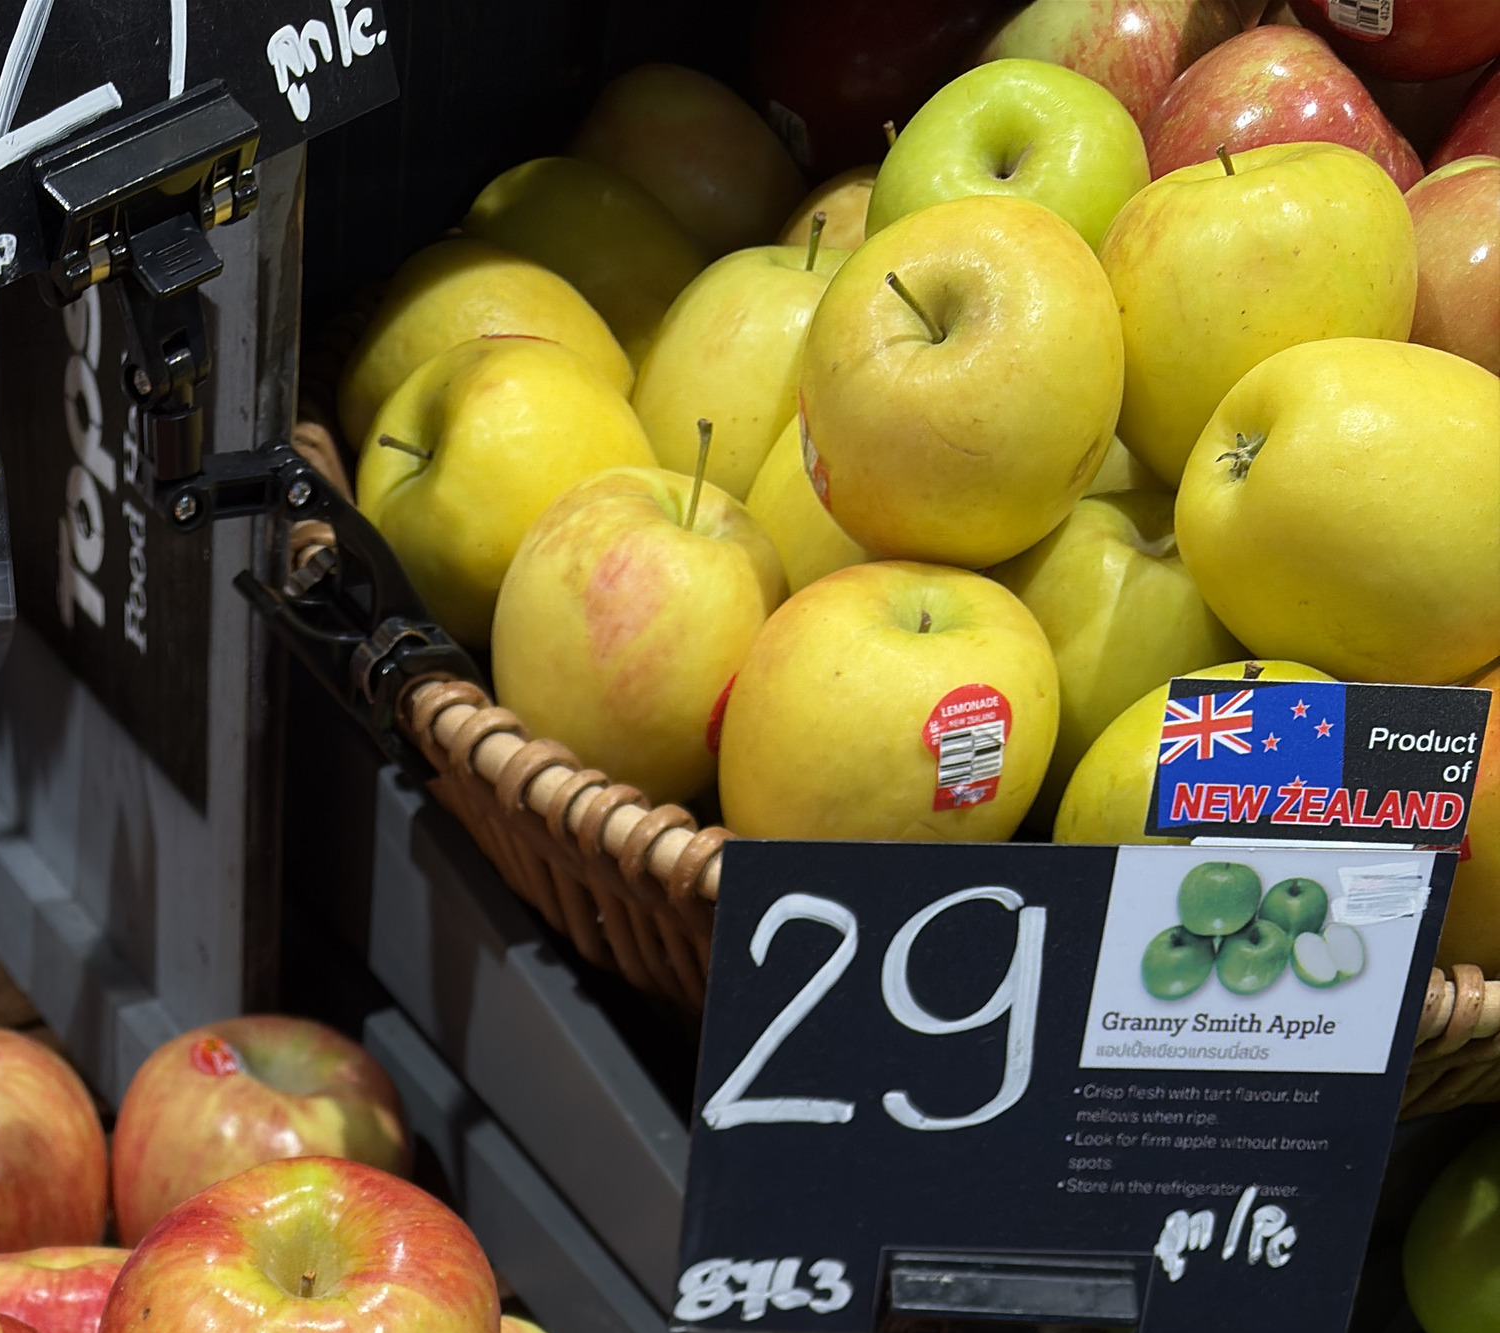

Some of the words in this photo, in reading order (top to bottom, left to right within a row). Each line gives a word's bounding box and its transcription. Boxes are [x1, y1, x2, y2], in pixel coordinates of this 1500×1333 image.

[122, 501, 148, 655] Food
[941, 696, 1000, 717] LEMONADE
[1368, 727, 1477, 754] Product
[1443, 760, 1474, 783] of
[1170, 782, 1270, 824] NEW
[1271, 786, 1466, 830] ZEALAND
[702, 886, 1046, 1130] 29
[1101, 1012, 1188, 1037] Granny
[1192, 1013, 1262, 1033] Smith
[1266, 1014, 1336, 1039] Apple
[1083, 1083, 1124, 1101] Crisp
[1128, 1084, 1165, 1100] flesh
[1168, 1086, 1200, 1100] with
[1204, 1087, 1232, 1101] tart
[1293, 1087, 1319, 1103] but
[1076, 1107, 1140, 1123] mellows
[1142, 1109, 1183, 1123] when
[1074, 1132, 1114, 1147] Look
[1116, 1132, 1139, 1147] for
[1140, 1132, 1171, 1147] firm
[1174, 1134, 1217, 1151] apple
[1220, 1136, 1277, 1150] without
[1279, 1136, 1328, 1151] brown
[1066, 1178, 1109, 1194] Store
[1110, 1179, 1125, 1194] in
[1127, 1179, 1152, 1194] the
[1154, 1180, 1243, 1198] refrigerator
